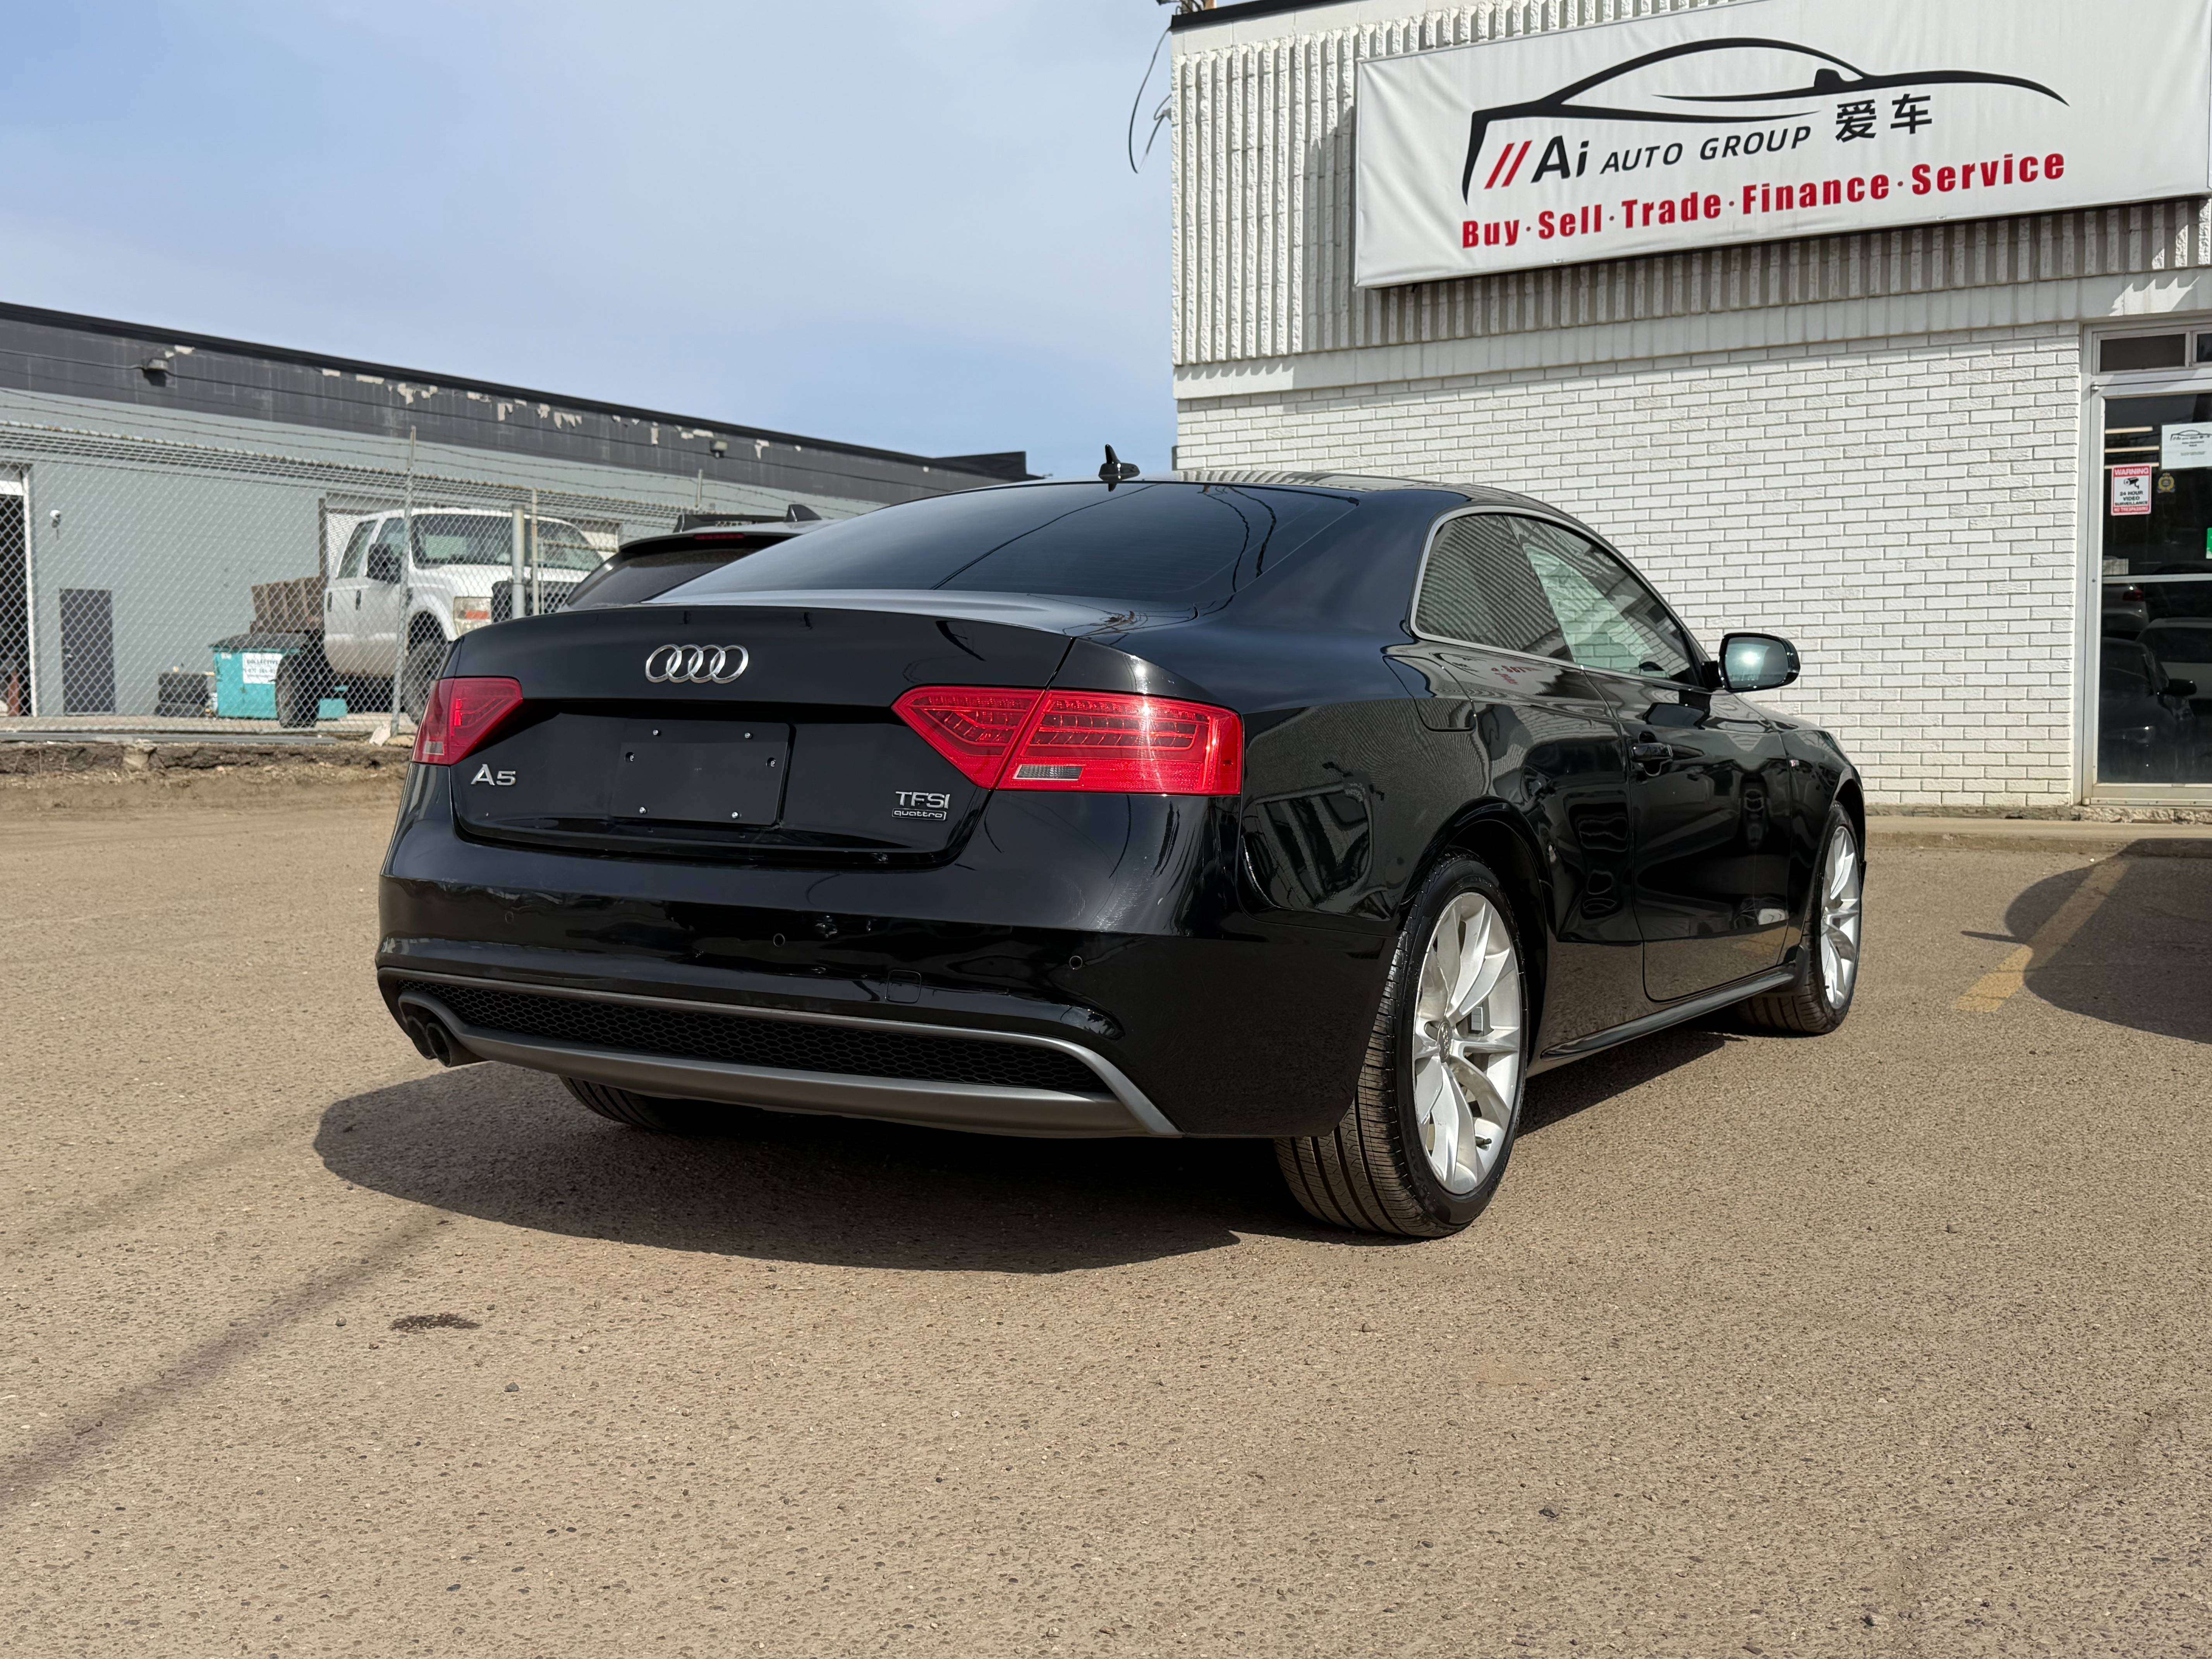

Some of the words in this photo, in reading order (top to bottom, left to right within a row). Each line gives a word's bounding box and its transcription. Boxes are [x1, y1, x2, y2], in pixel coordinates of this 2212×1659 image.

[1835, 93, 1932, 143] 爱车
[1600, 143, 1683, 174] AUTO
[1700, 126, 1811, 160] GROUP
[471, 764, 516, 785] A5
[896, 791, 950, 809] TFSI
